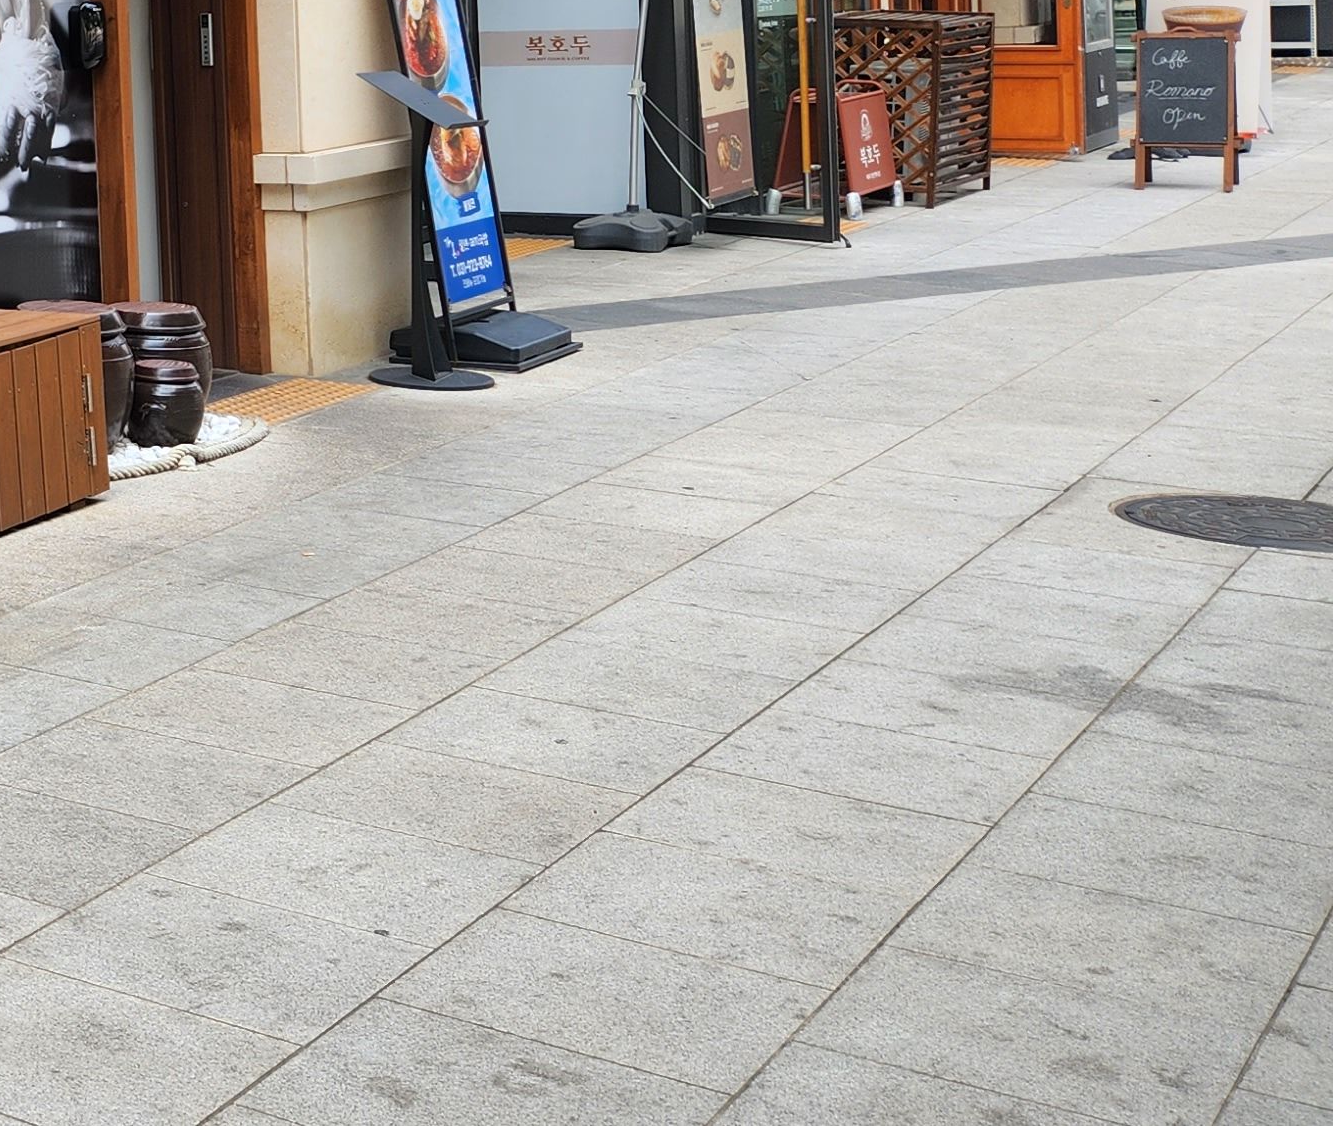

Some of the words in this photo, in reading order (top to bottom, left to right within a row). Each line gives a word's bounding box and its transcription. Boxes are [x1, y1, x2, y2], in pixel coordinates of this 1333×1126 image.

[524, 35, 591, 56] 복호두
[1151, 47, 1192, 70] Caffe
[1144, 79, 1217, 98] Romano
